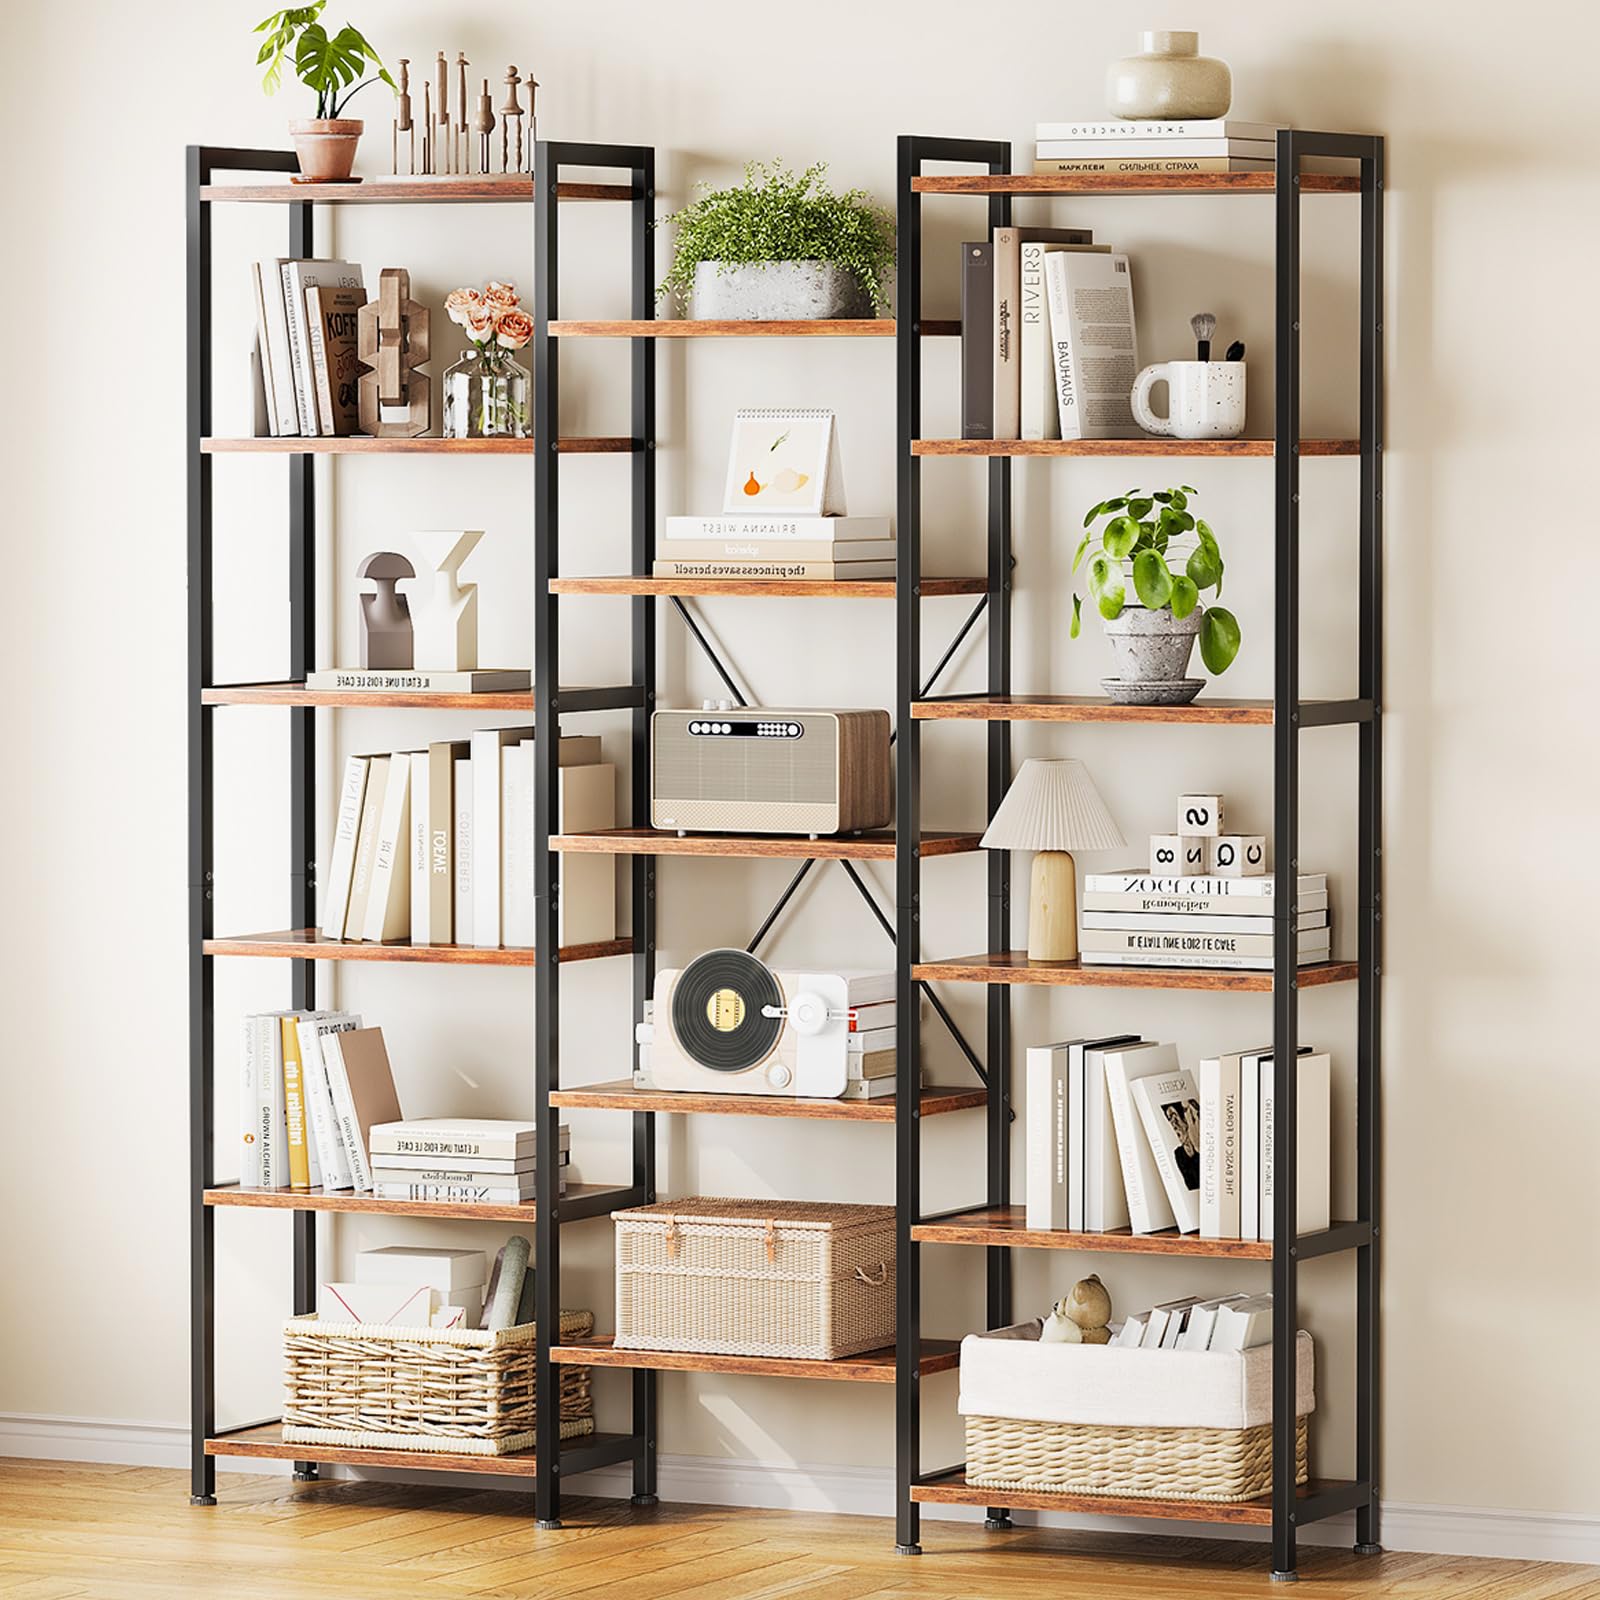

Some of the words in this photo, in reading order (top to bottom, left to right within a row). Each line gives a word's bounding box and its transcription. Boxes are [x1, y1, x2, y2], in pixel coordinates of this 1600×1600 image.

[1119, 163, 1162, 171] СИЛЬНЕЕ
[1165, 162, 1199, 170] СТРАХА
[1024, 247, 1040, 324] RIVERS
[326, 312, 357, 341] KOFF
[1057, 341, 1074, 407] BAUHAUS
[1156, 848, 1175, 863] 8
[1217, 843, 1235, 867] Q
